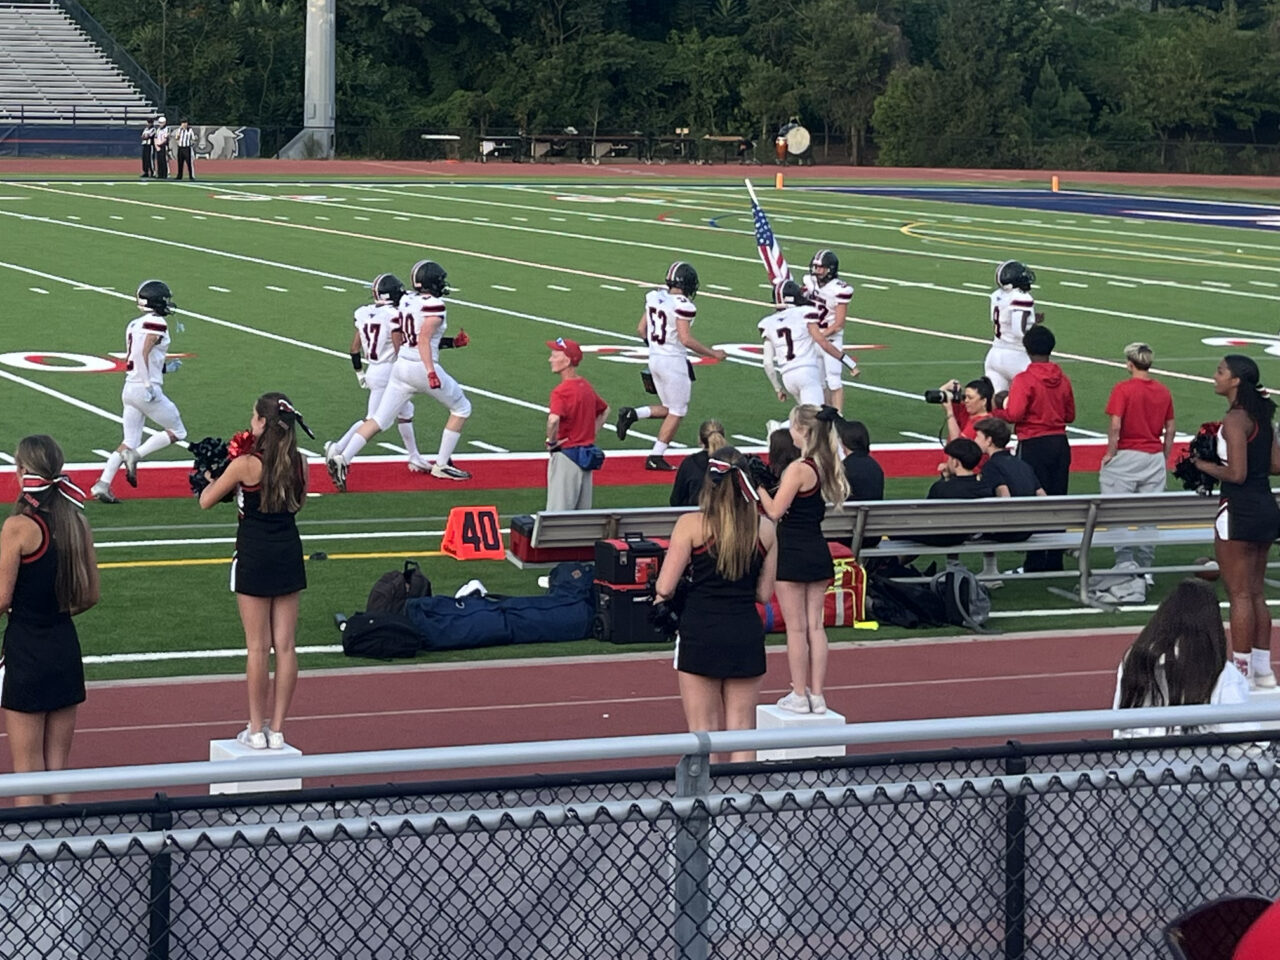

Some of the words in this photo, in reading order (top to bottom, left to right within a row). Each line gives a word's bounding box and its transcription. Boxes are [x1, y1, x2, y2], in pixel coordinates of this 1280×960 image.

[363, 323, 381, 361] 17
[648, 306, 667, 345] 53
[776, 327, 796, 361] 7
[462, 510, 501, 552] 40
